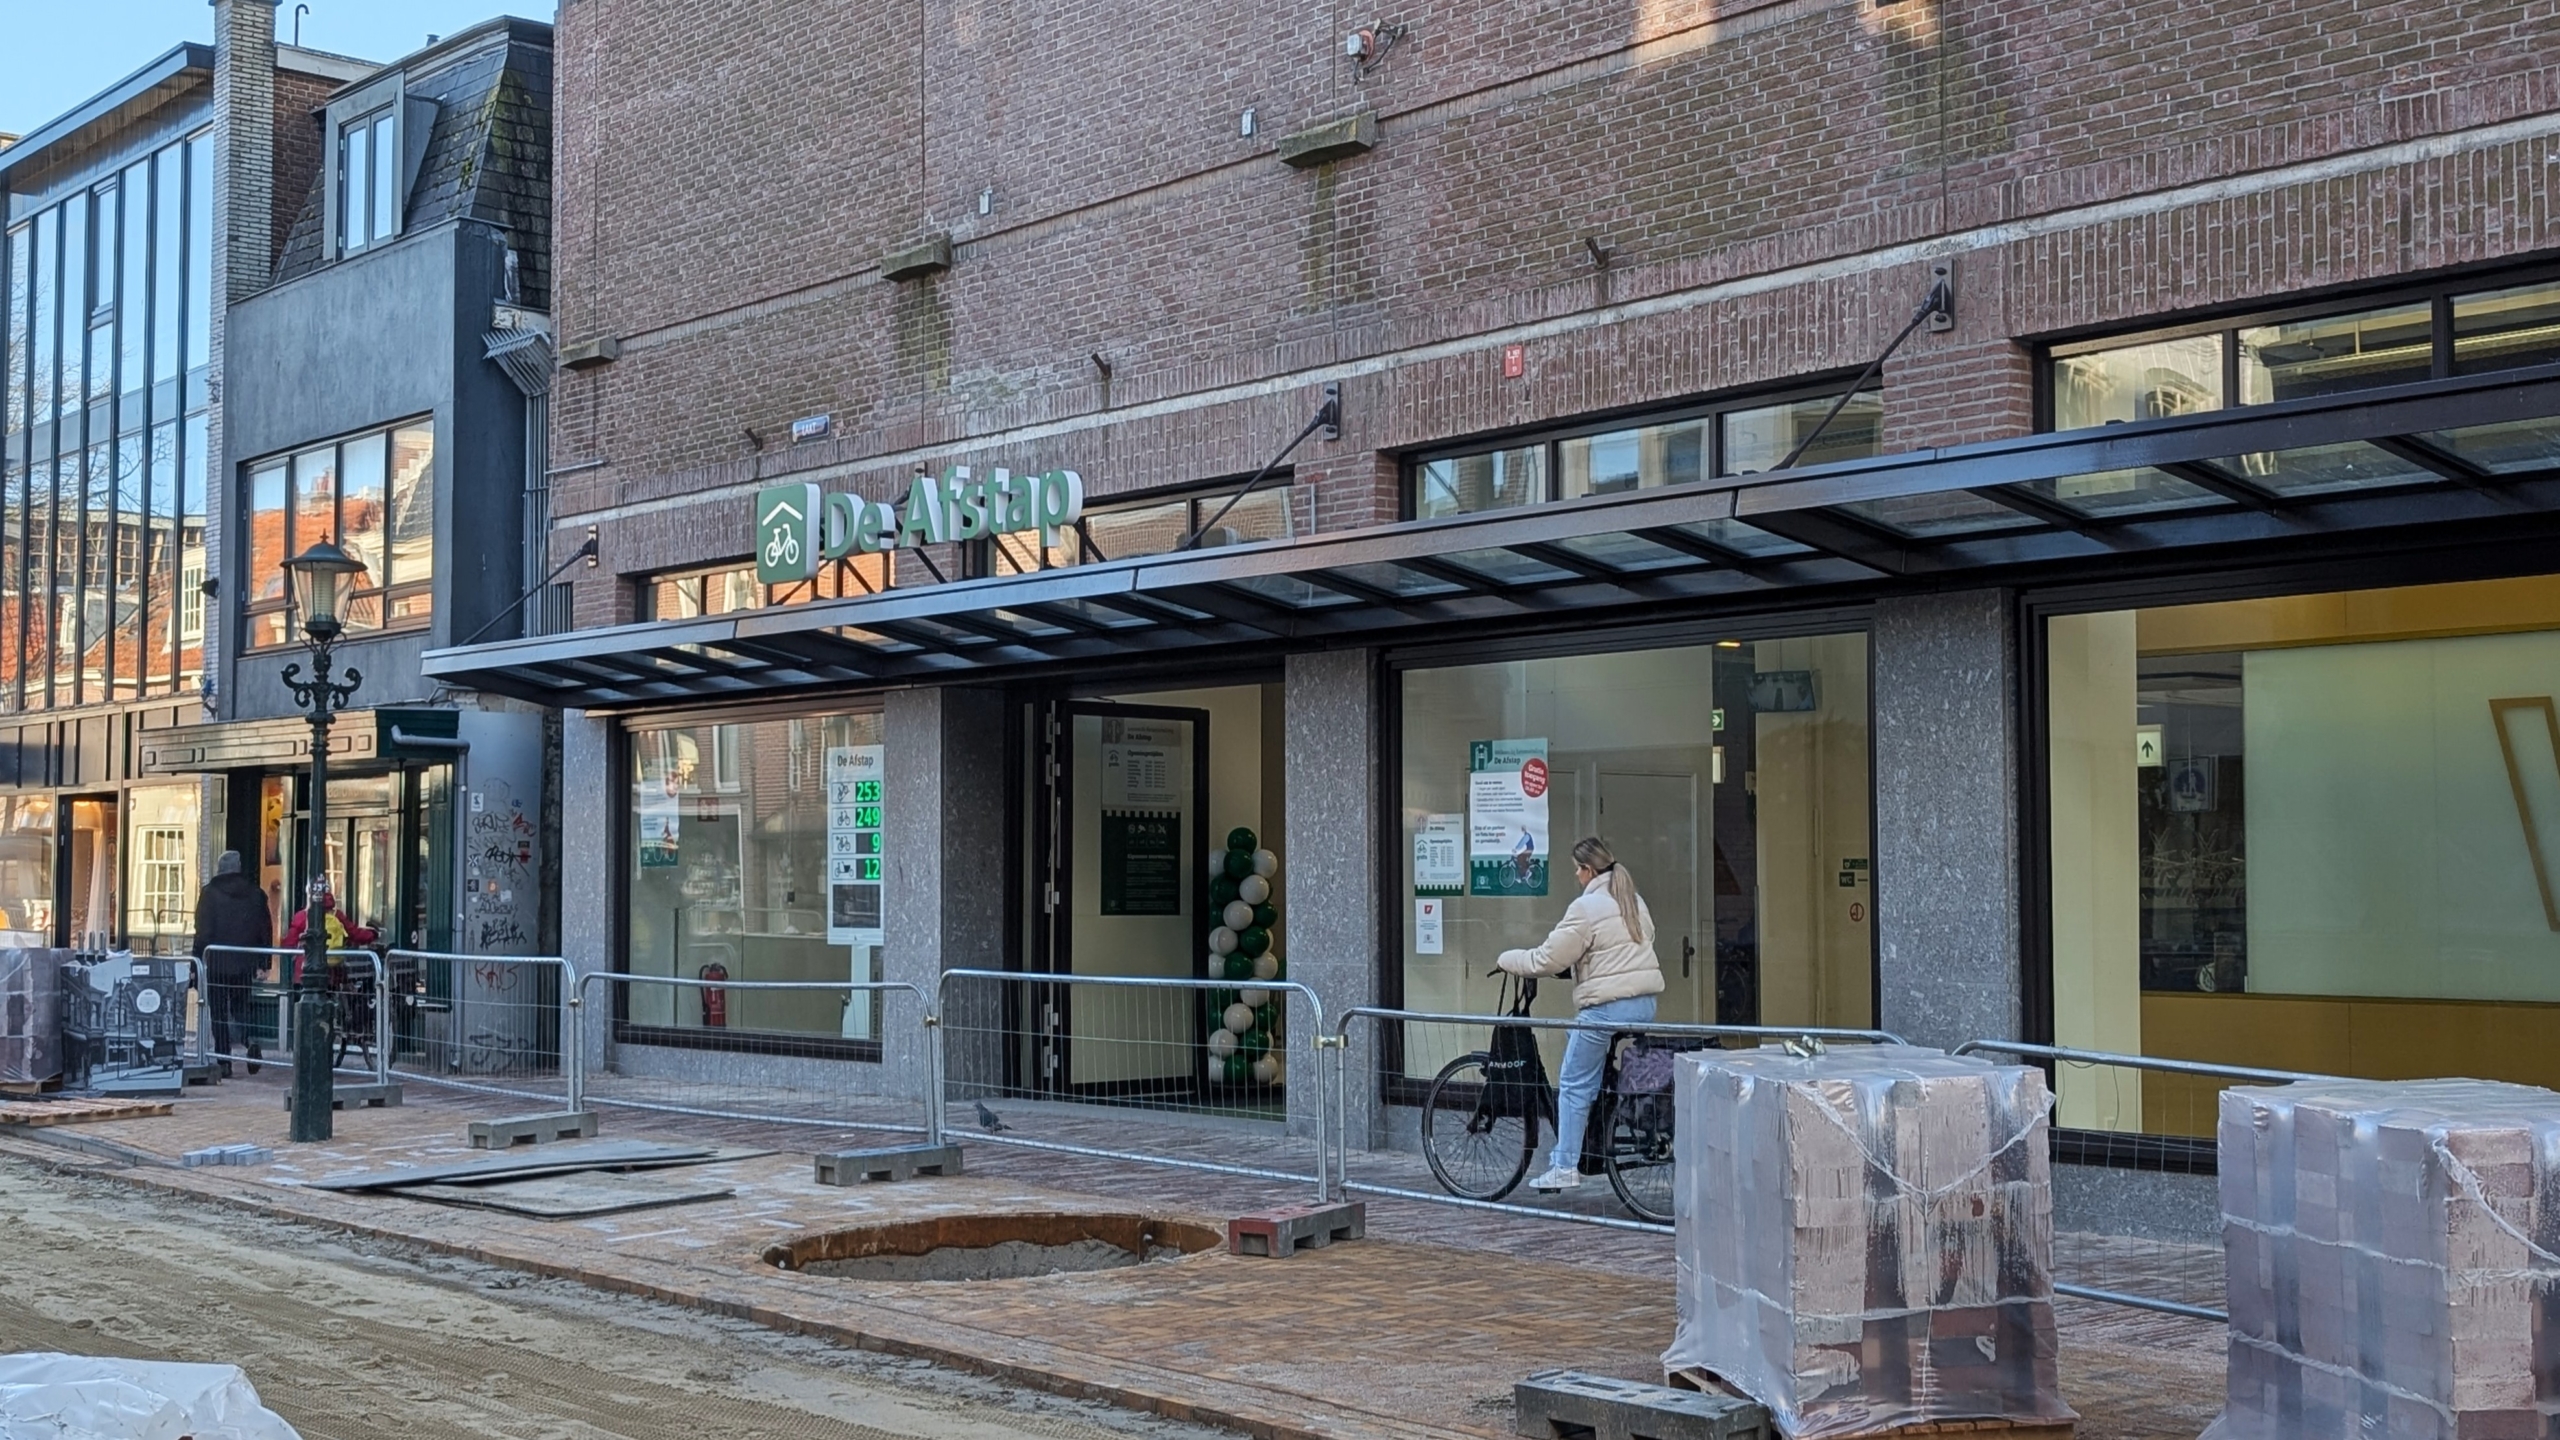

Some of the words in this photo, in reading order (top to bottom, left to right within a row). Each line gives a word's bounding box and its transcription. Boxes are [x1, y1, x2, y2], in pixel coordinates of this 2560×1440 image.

[824, 492, 895, 559] De
[899, 465, 1083, 548] Afstap
[837, 755, 847, 767] De
[849, 754, 873, 768] Afstap
[1494, 757, 1502, 765] De
[1503, 756, 1521, 765] Afstap
[1528, 764, 1544, 775] Gratis
[856, 782, 880, 801] 253
[856, 808, 880, 827] 249
[873, 834, 880, 852] 9
[864, 860, 880, 879] 12
[1841, 876, 1852, 884] WC
